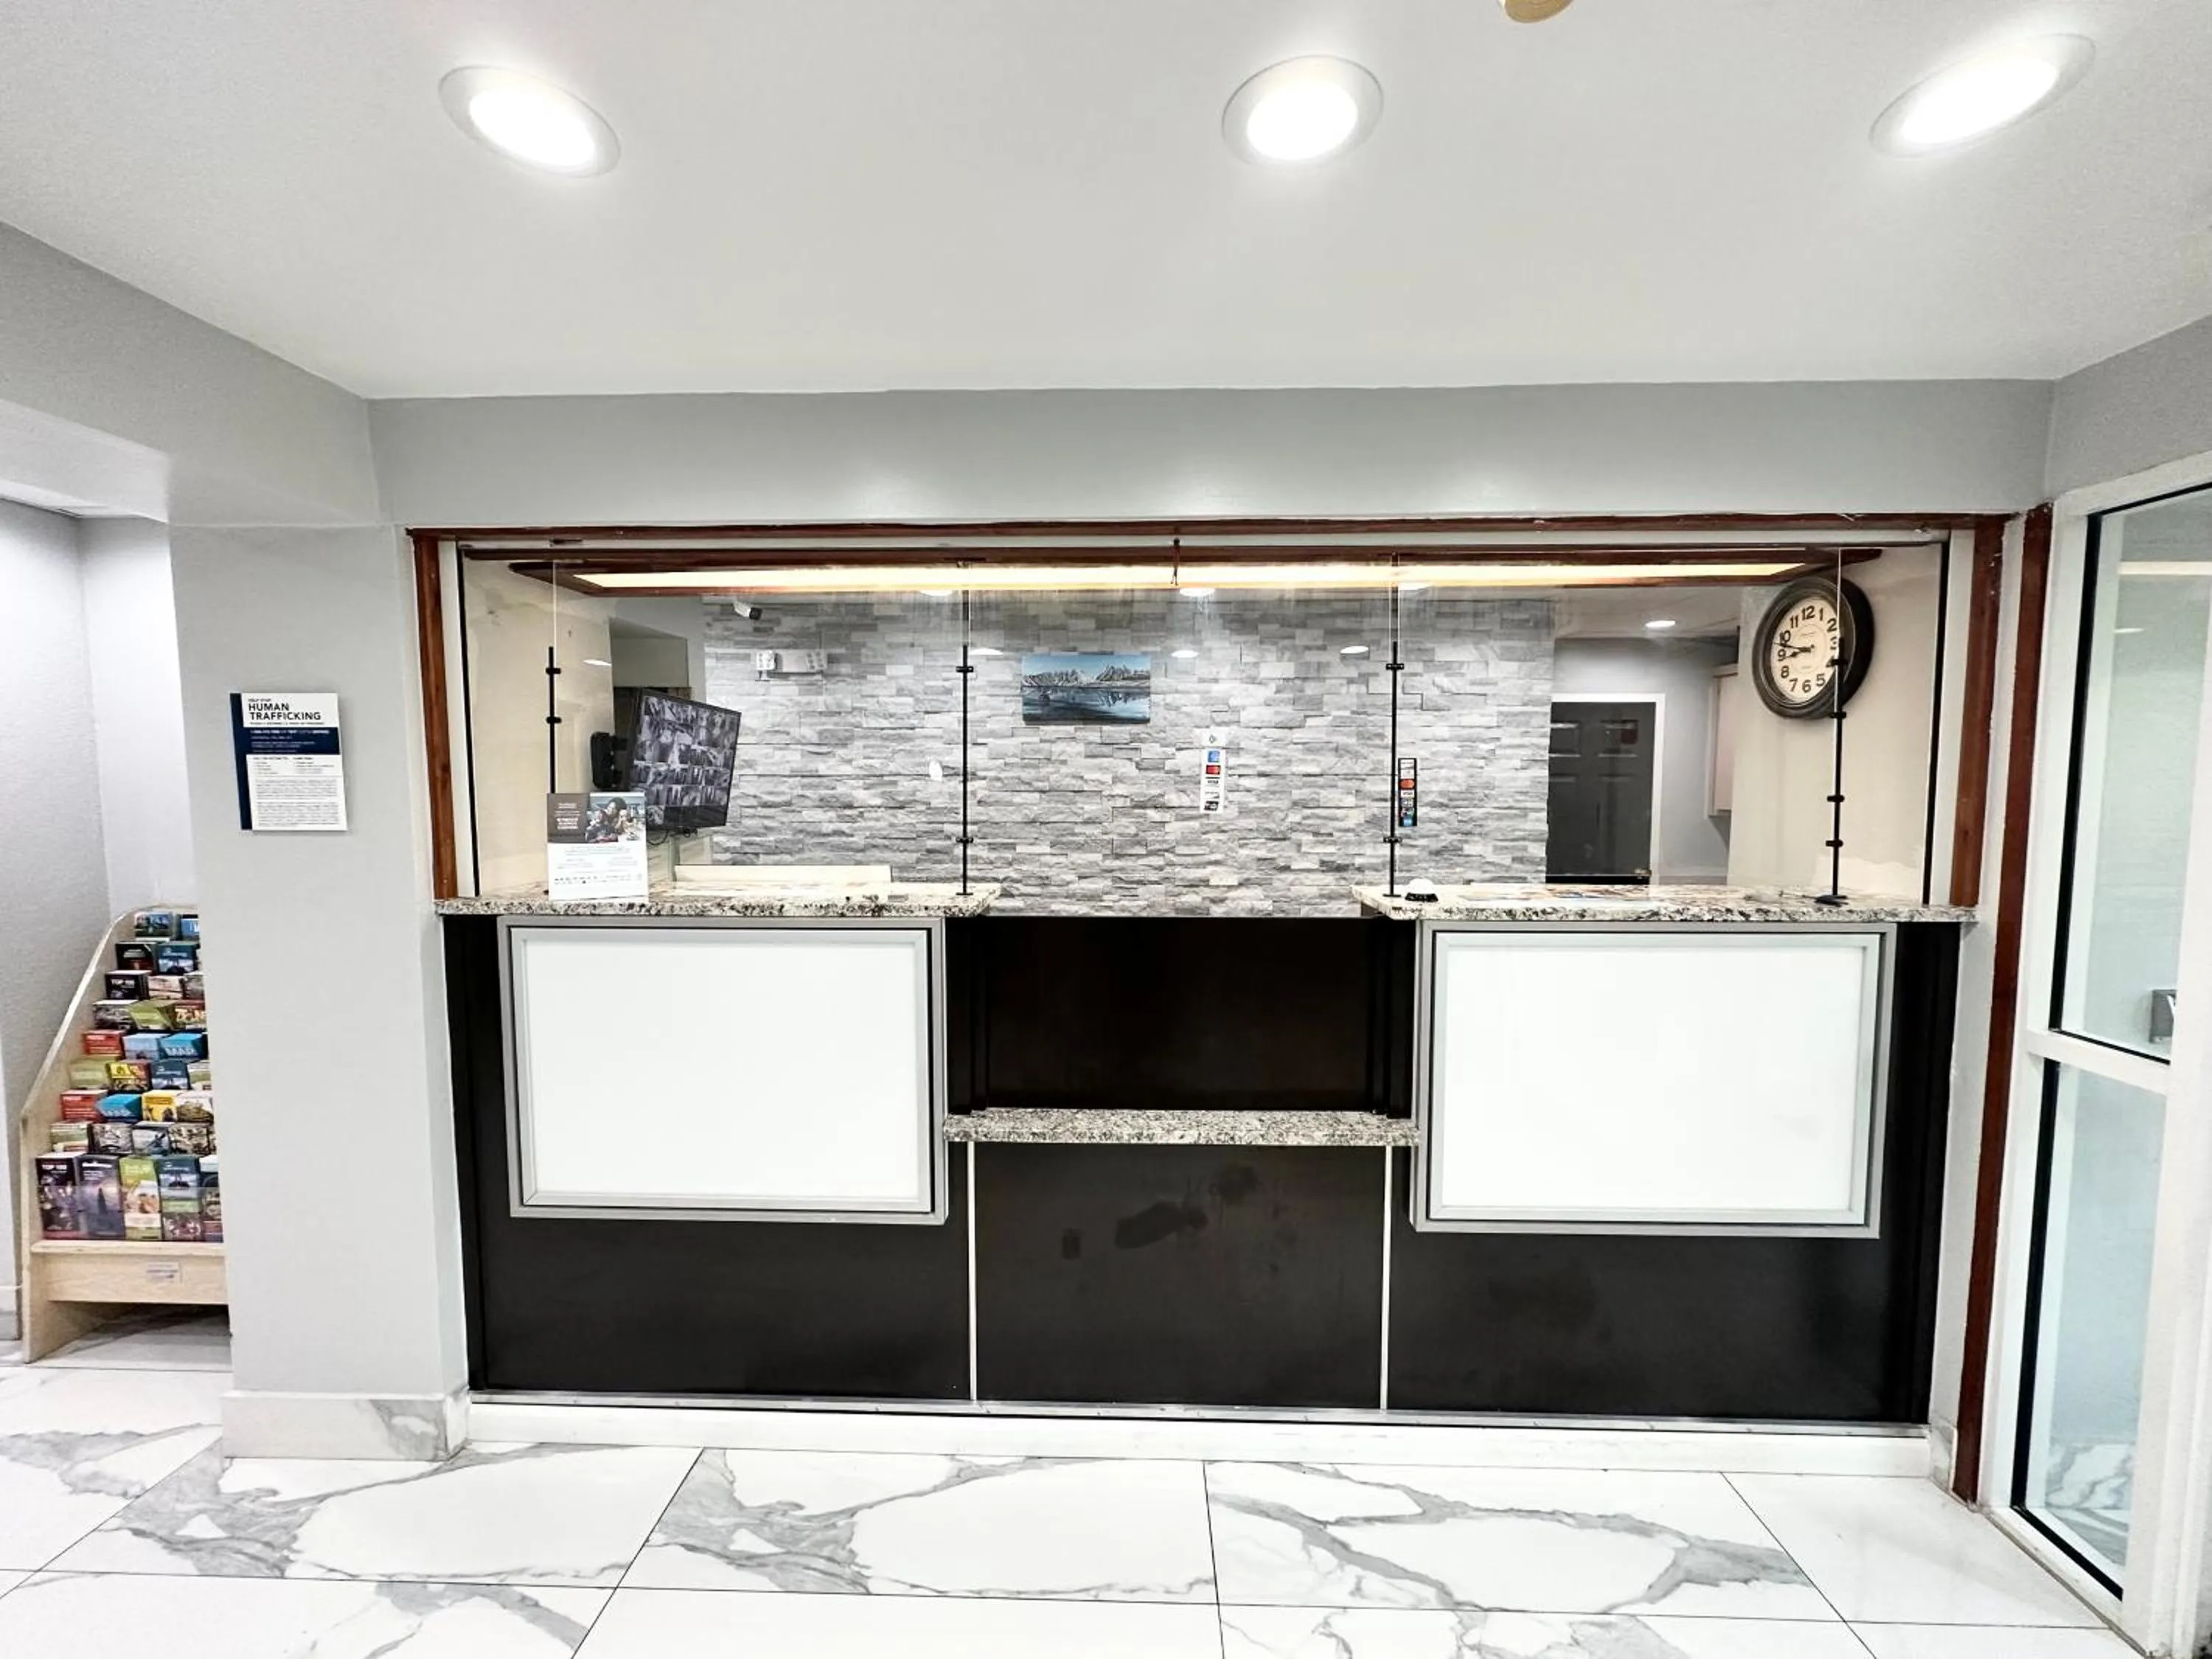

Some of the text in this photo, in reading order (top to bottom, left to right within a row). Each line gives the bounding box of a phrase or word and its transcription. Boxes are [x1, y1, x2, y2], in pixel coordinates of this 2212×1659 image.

[1801, 605, 1815, 620] 12
[1818, 608, 1823, 621] 1
[1790, 616, 1798, 628] 11
[1827, 619, 1837, 632] 2
[1779, 630, 1791, 644] 10
[1778, 649, 1787, 661] 9
[1781, 667, 1790, 678] 8
[1790, 678, 1798, 692] 7
[1801, 679, 1811, 693] 6
[1816, 674, 1825, 686] 5
[248, 703, 290, 711] HUMAN
[250, 712, 321, 720] TRAFFICKING
